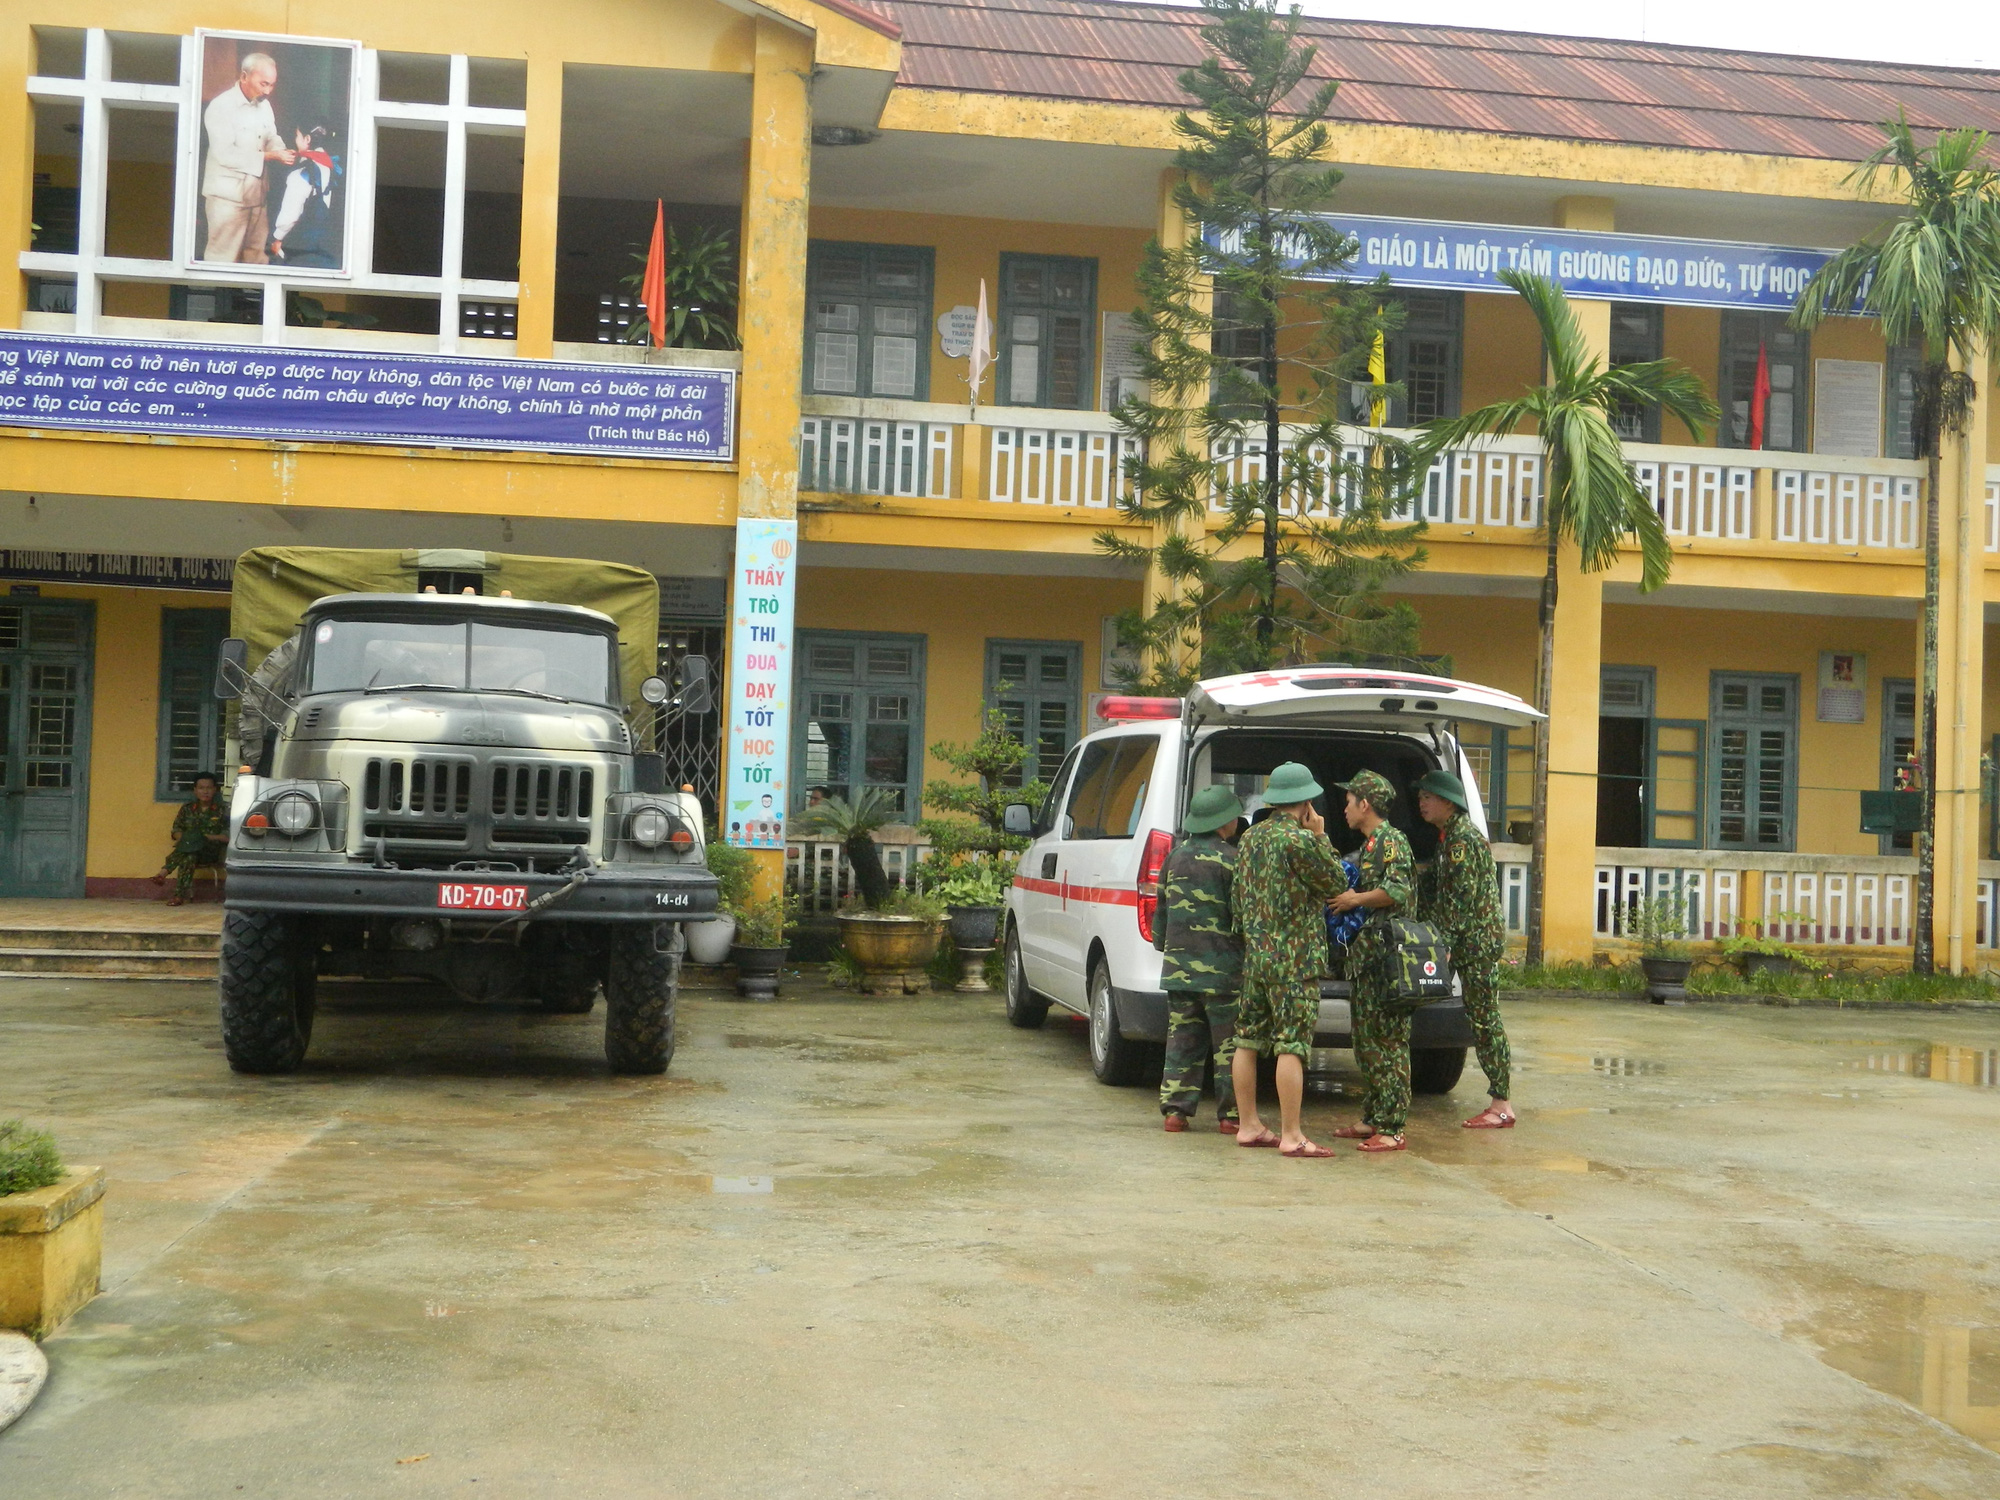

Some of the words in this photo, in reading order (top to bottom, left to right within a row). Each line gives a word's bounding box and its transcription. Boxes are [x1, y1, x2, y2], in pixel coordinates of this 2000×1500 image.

[1367, 233, 1416, 267] GIÁO
[1423, 236, 1448, 269] LÀ
[1455, 239, 1501, 278] MỘT
[1507, 239, 1552, 276] TẤM
[1558, 250, 1630, 282] GƯƠNG
[1636, 256, 1678, 290] ĐẠO
[1684, 256, 1732, 293] ĐỨC,
[1738, 263, 1766, 297] TỰ
[1770, 266, 1810, 299] HỌC
[27, 349, 60, 368] Việt
[64, 351, 105, 368] Nam
[110, 354, 134, 369] có
[140, 353, 164, 371] trở
[168, 357, 201, 373] nên
[206, 359, 238, 375] tươi
[242, 361, 277, 380] đẹp
[282, 363, 326, 382] được
[331, 365, 364, 385] hay
[367, 367, 422, 388] không,
[429, 371, 462, 387] dân
[467, 373, 495, 391] tộc
[501, 375, 533, 394] Việt
[537, 377, 575, 393] Nam
[580, 379, 603, 395] có
[607, 380, 650, 397] bước
[654, 383, 676, 398] tới
[680, 384, 708, 400] đài
[23, 371, 64, 388] sánh
[71, 375, 97, 389] vai
[103, 375, 129, 391] với
[133, 377, 168, 393] các
[173, 380, 228, 400] cường
[233, 382, 277, 401] quốc
[282, 385, 320, 401] năm
[325, 388, 369, 404] châu
[373, 390, 417, 409] được
[421, 392, 454, 411] hay
[457, 394, 512, 415] không,
[519, 398, 563, 414] chính
[567, 399, 584, 415] là
[589, 401, 621, 417] nhờ
[625, 403, 658, 422] một
[660, 403, 703, 422] phần
[32, 394, 62, 413] tập
[68, 394, 102, 412] của
[107, 398, 142, 414] các
[147, 403, 175, 416] em
[588, 425, 628, 441] (Trích
[631, 426, 655, 441] thư
[657, 427, 683, 443] Bác
[686, 427, 710, 446] Hồ)
[211, 559, 235, 582] SIN
[745, 563, 785, 587] THẦY
[748, 594, 780, 614] TRÒ
[750, 626, 776, 642] THI
[746, 654, 777, 671] ĐUA
[745, 682, 776, 702] DẠY
[745, 705, 774, 727] TỐT
[743, 739, 775, 758] HỌC
[743, 761, 772, 783] TỐT
[441, 884, 525, 908] KD-70-07
[655, 892, 689, 906] 14-d4
